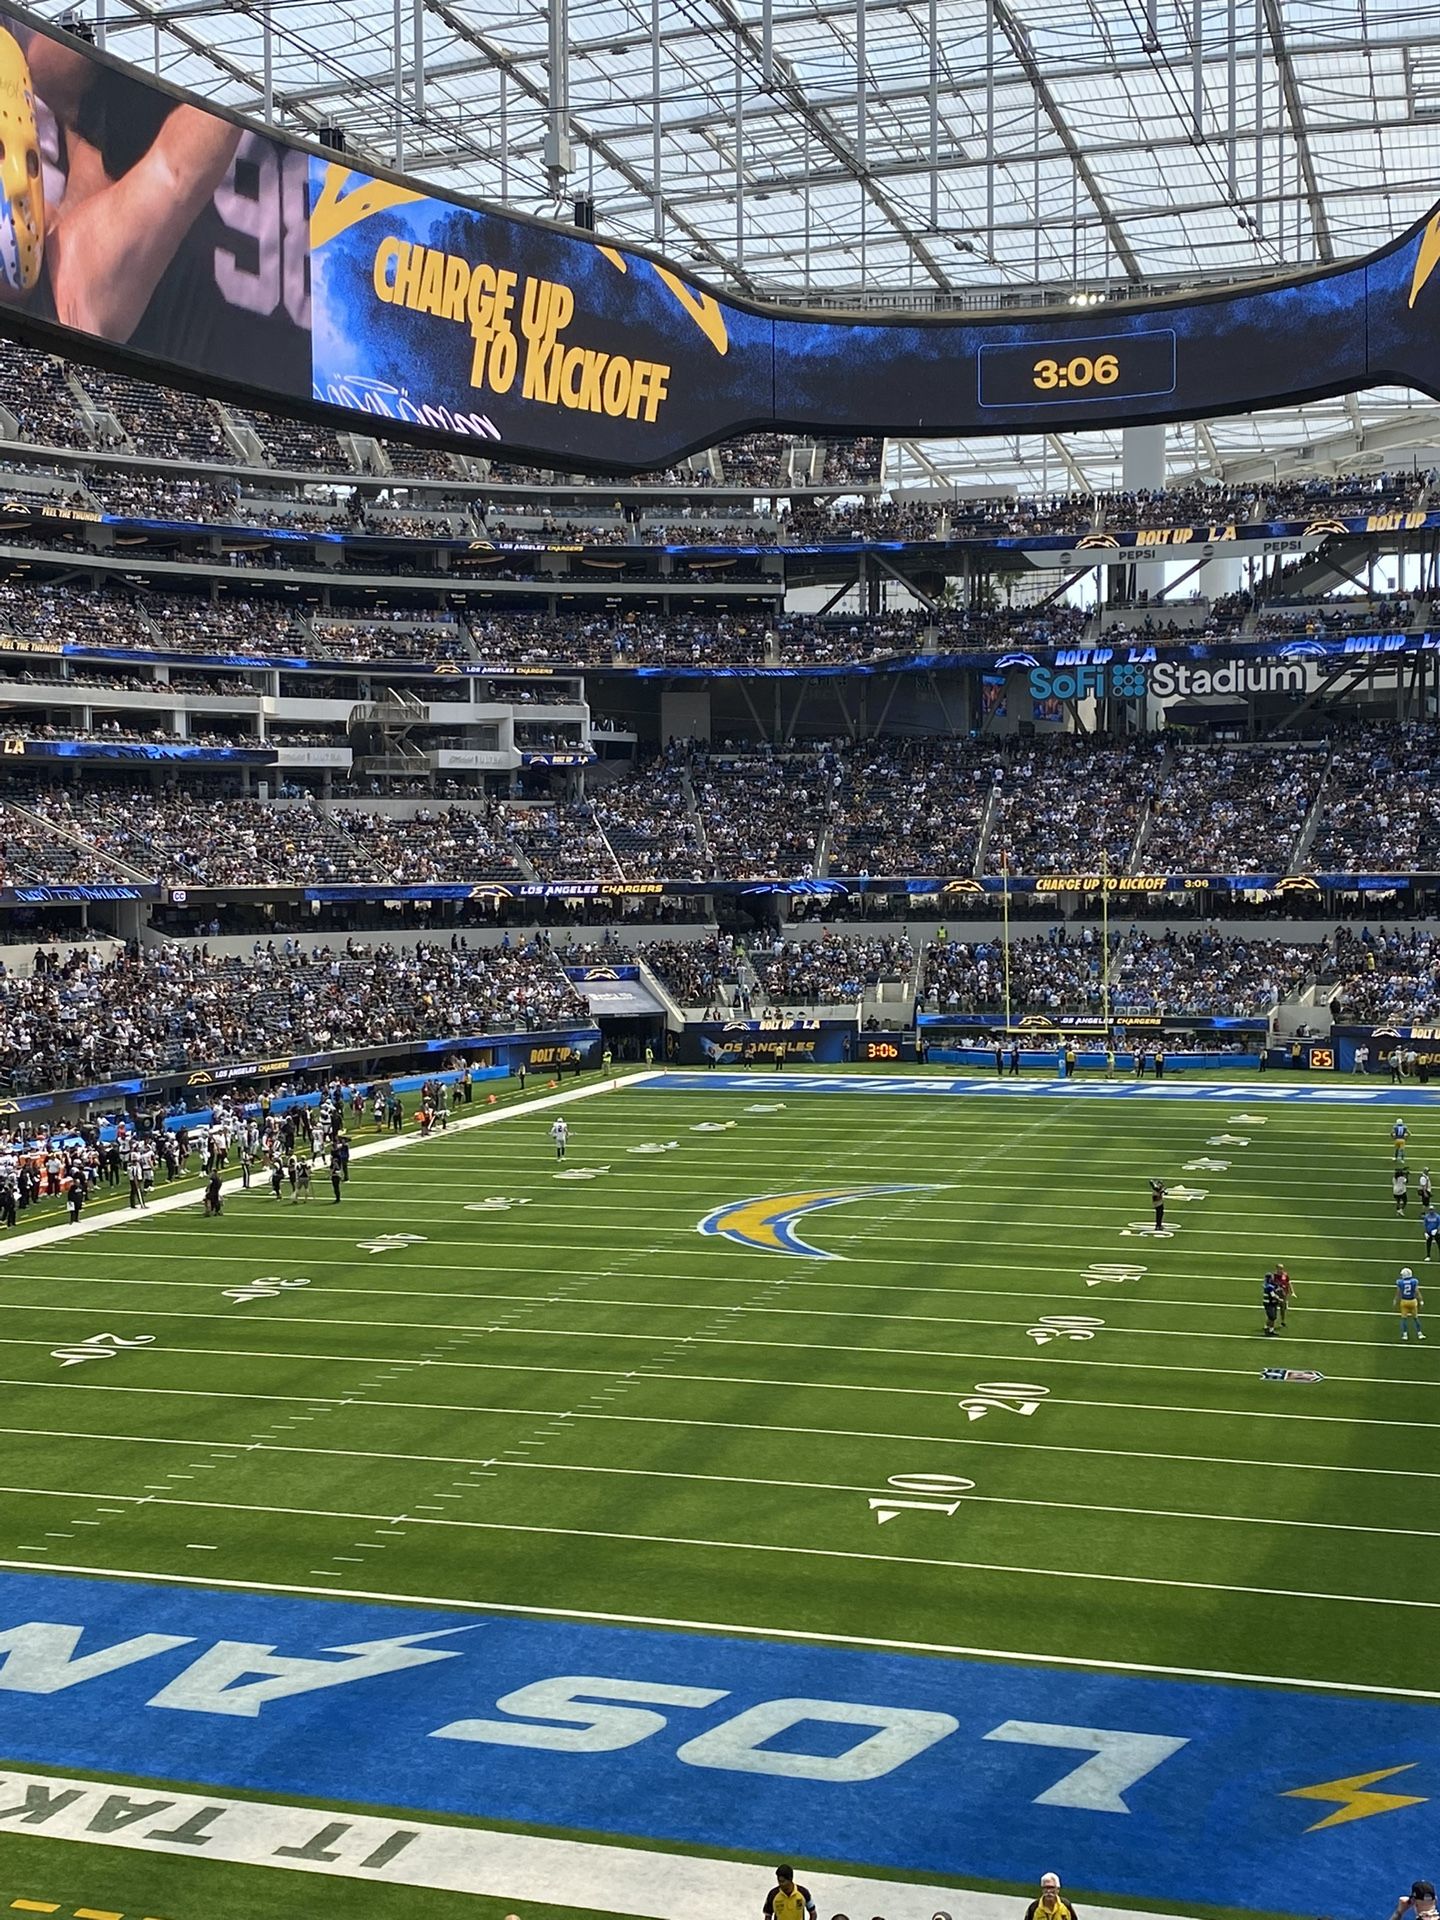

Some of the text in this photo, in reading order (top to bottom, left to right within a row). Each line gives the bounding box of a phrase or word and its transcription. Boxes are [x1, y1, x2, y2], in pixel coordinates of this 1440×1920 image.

[374, 236, 574, 342] CHARGE UP
[470, 322, 518, 394] TO
[522, 342, 671, 422] KICKOFF
[1033, 354, 1119, 389] 3:06
[42, 507, 102, 522] FEEL THE THUNDE
[1365, 511, 1427, 532] BOLT UP
[1135, 526, 1236, 546] BOLT UP LA
[1119, 549, 1156, 564] PEPSI
[1264, 541, 1302, 556] PEPSI
[31, 642, 61, 653] THUNDE
[1344, 636, 1383, 653] BOLT
[1384, 634, 1406, 652] UP
[1055, 646, 1158, 666] BOLT UP LA
[1030, 660, 1306, 699] SoFi Stadium
[3, 741, 25, 755] LA
[520, 884, 664, 897] LOS ANGELES CHARGERS
[1035, 877, 1209, 891] CHARGE UP TO KICKOFF 3:06
[174, 892, 187, 900] CC
[759, 1020, 780, 1030] BOLT
[781, 1020, 795, 1030] UP
[1116, 1017, 1162, 1026] CHARGERS
[1411, 1028, 1434, 1039] BOLT
[530, 1048, 555, 1063] BOLT
[869, 1043, 898, 1058] 3:06
[1312, 1051, 1332, 1066] 25
[215, 1061, 290, 1079] LOS ANGELES CHARGERS
[727, 1079, 1392, 1099] CHARGERS
[356, 1232, 429, 1250] 40
[1080, 1263, 1147, 1283] 40
[221, 1276, 312, 1299] 30
[1403, 1284, 1412, 1295] 2
[1026, 1315, 1105, 1341] 30
[50, 1332, 156, 1361] 20
[958, 1382, 1051, 1416] 20
[868, 1472, 976, 1516] 10
[428, 1675, 1190, 1815] LOS
[272, 1821, 420, 1869] IT
